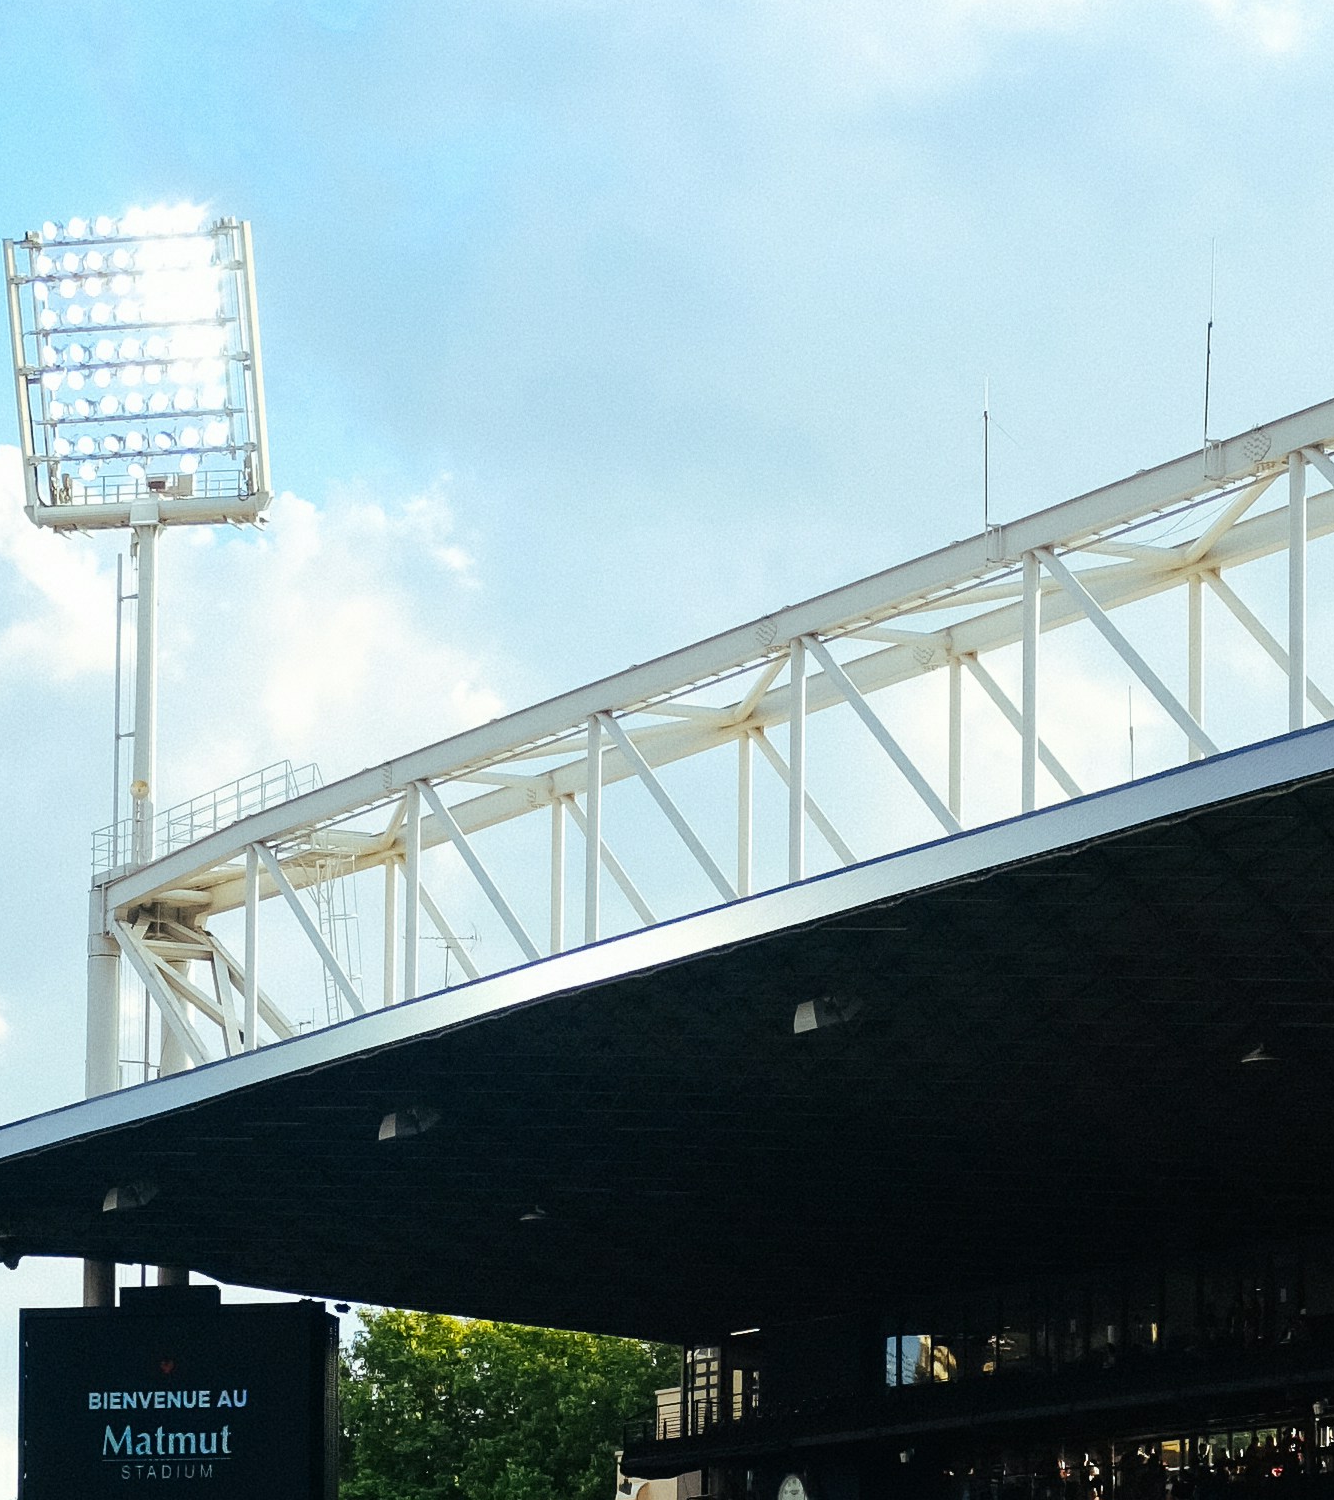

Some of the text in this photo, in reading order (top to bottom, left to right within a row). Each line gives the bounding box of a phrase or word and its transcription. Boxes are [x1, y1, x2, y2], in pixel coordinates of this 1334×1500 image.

[88, 1389, 248, 1410] BIENVENUE AU
[102, 1424, 232, 1456] Matmut
[121, 1463, 213, 1480] STADIUM
